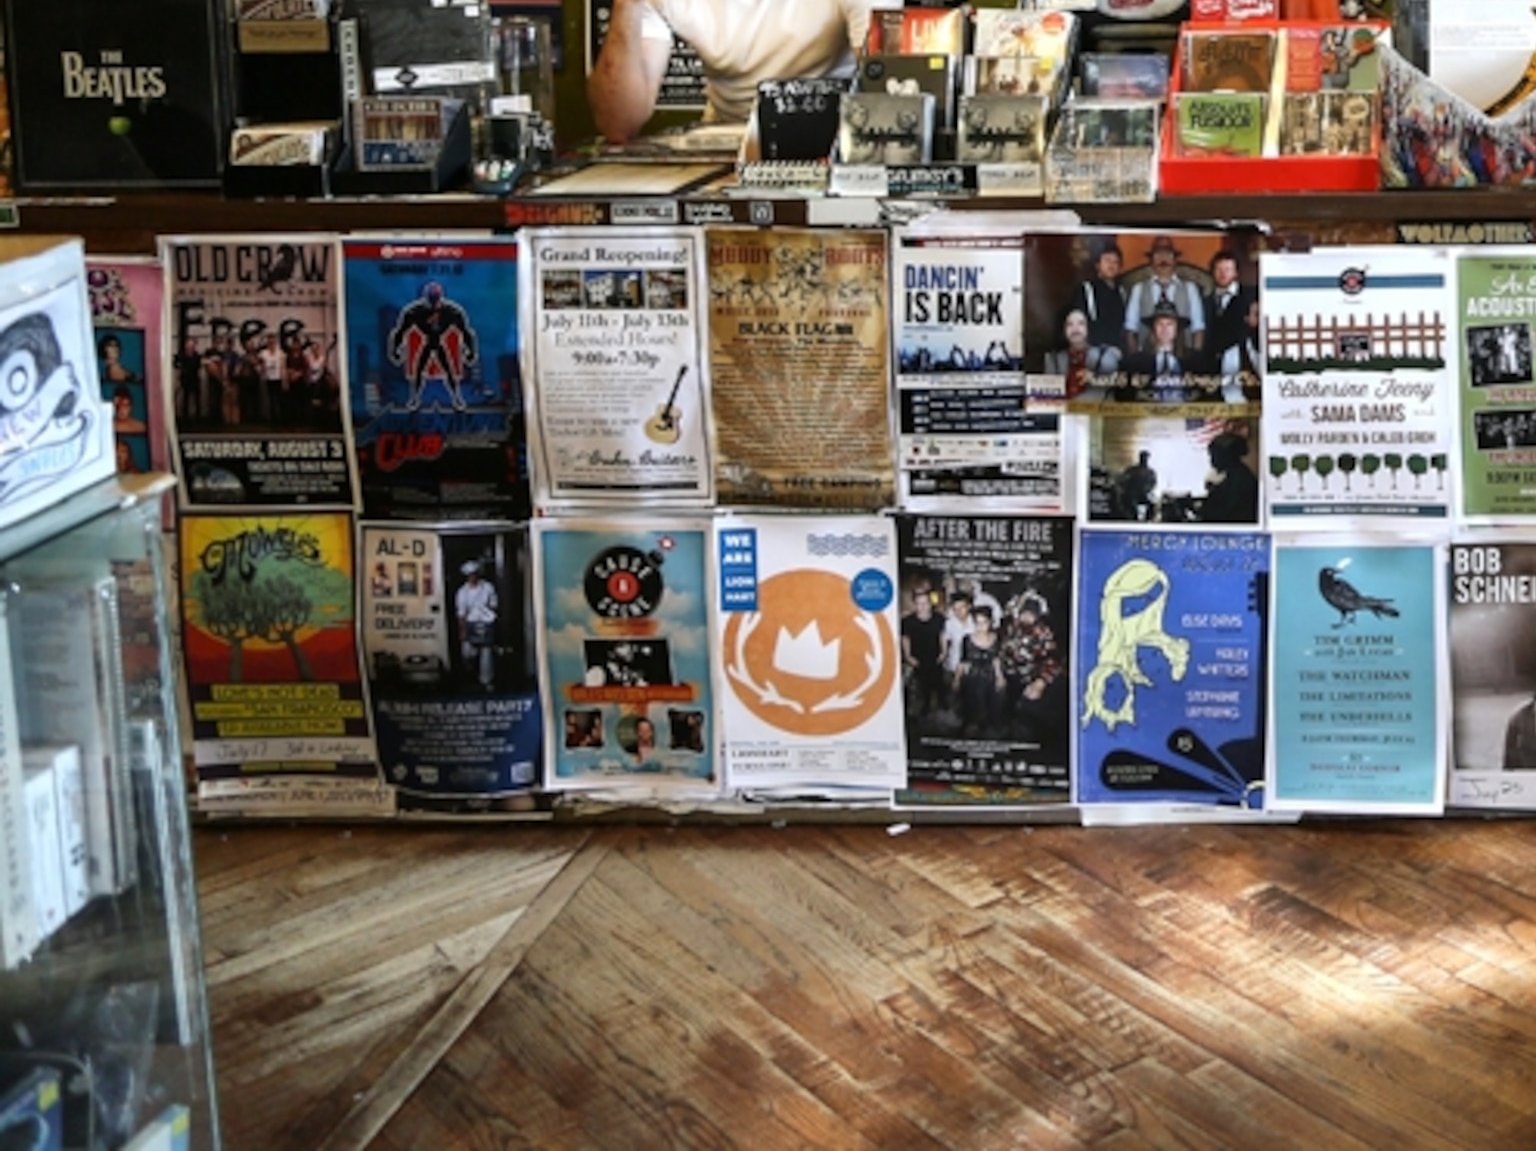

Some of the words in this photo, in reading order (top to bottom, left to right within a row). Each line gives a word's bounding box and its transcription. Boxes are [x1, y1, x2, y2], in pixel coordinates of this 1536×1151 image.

[101, 51, 123, 64] THE
[61, 51, 166, 105] BEATLES
[175, 245, 229, 283] OLD
[540, 247, 590, 263] Grand
[595, 247, 688, 265] Reopening!
[903, 263, 985, 290] DANCIN'
[904, 293, 931, 324] IS
[936, 292, 1004, 326] BACK
[542, 314, 573, 330] July
[623, 314, 651, 331] July
[657, 313, 689, 327] 13th
[738, 322, 790, 336] BLACK
[795, 322, 833, 336] FLAG
[554, 331, 622, 347] Extended
[628, 330, 679, 347] Hours!
[1278, 378, 1369, 399] Catherine
[1310, 404, 1356, 423] SAMA
[1359, 403, 1406, 422] DAMS
[182, 440, 265, 461] SATURDAY,
[268, 439, 327, 459] AUGUST
[330, 439, 344, 458] 3
[914, 519, 970, 540] AFTER
[973, 520, 1008, 540] THE
[1013, 522, 1051, 542] FIRE
[376, 539, 426, 557] AL-D
[725, 533, 751, 547] WE
[1126, 535, 1187, 550] MERCY
[1192, 535, 1265, 551] LOUNGE
[723, 552, 753, 564] ARE
[1453, 547, 1502, 575] BOB
[725, 576, 754, 588] LION
[725, 592, 755, 602] HART
[486, 699, 533, 715] PARTY
